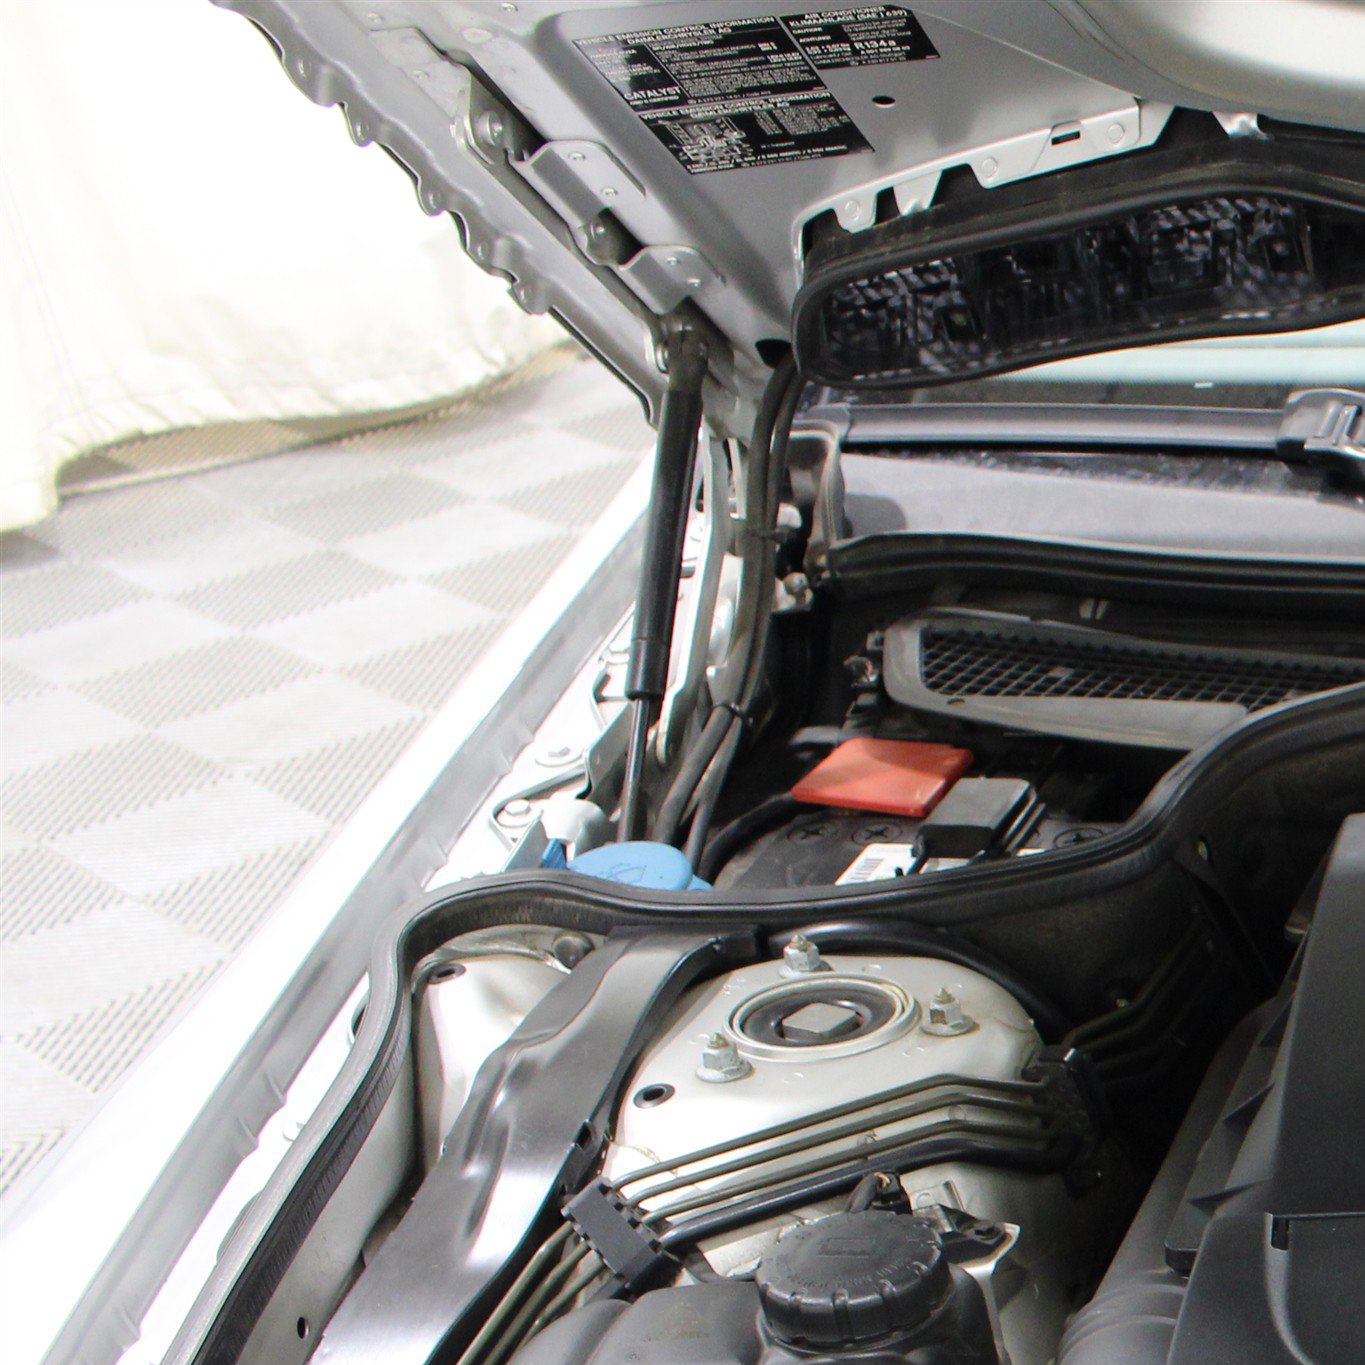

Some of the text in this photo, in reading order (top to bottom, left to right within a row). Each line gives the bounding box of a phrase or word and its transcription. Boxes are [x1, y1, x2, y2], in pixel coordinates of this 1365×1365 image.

[821, 6, 886, 18] CONDITIONER
[708, 16, 775, 29] INFORMATION
[789, 15, 856, 26] KLIMAANLAGE
[853, 40, 897, 50] R134a
[623, 86, 680, 101] CATALYST
